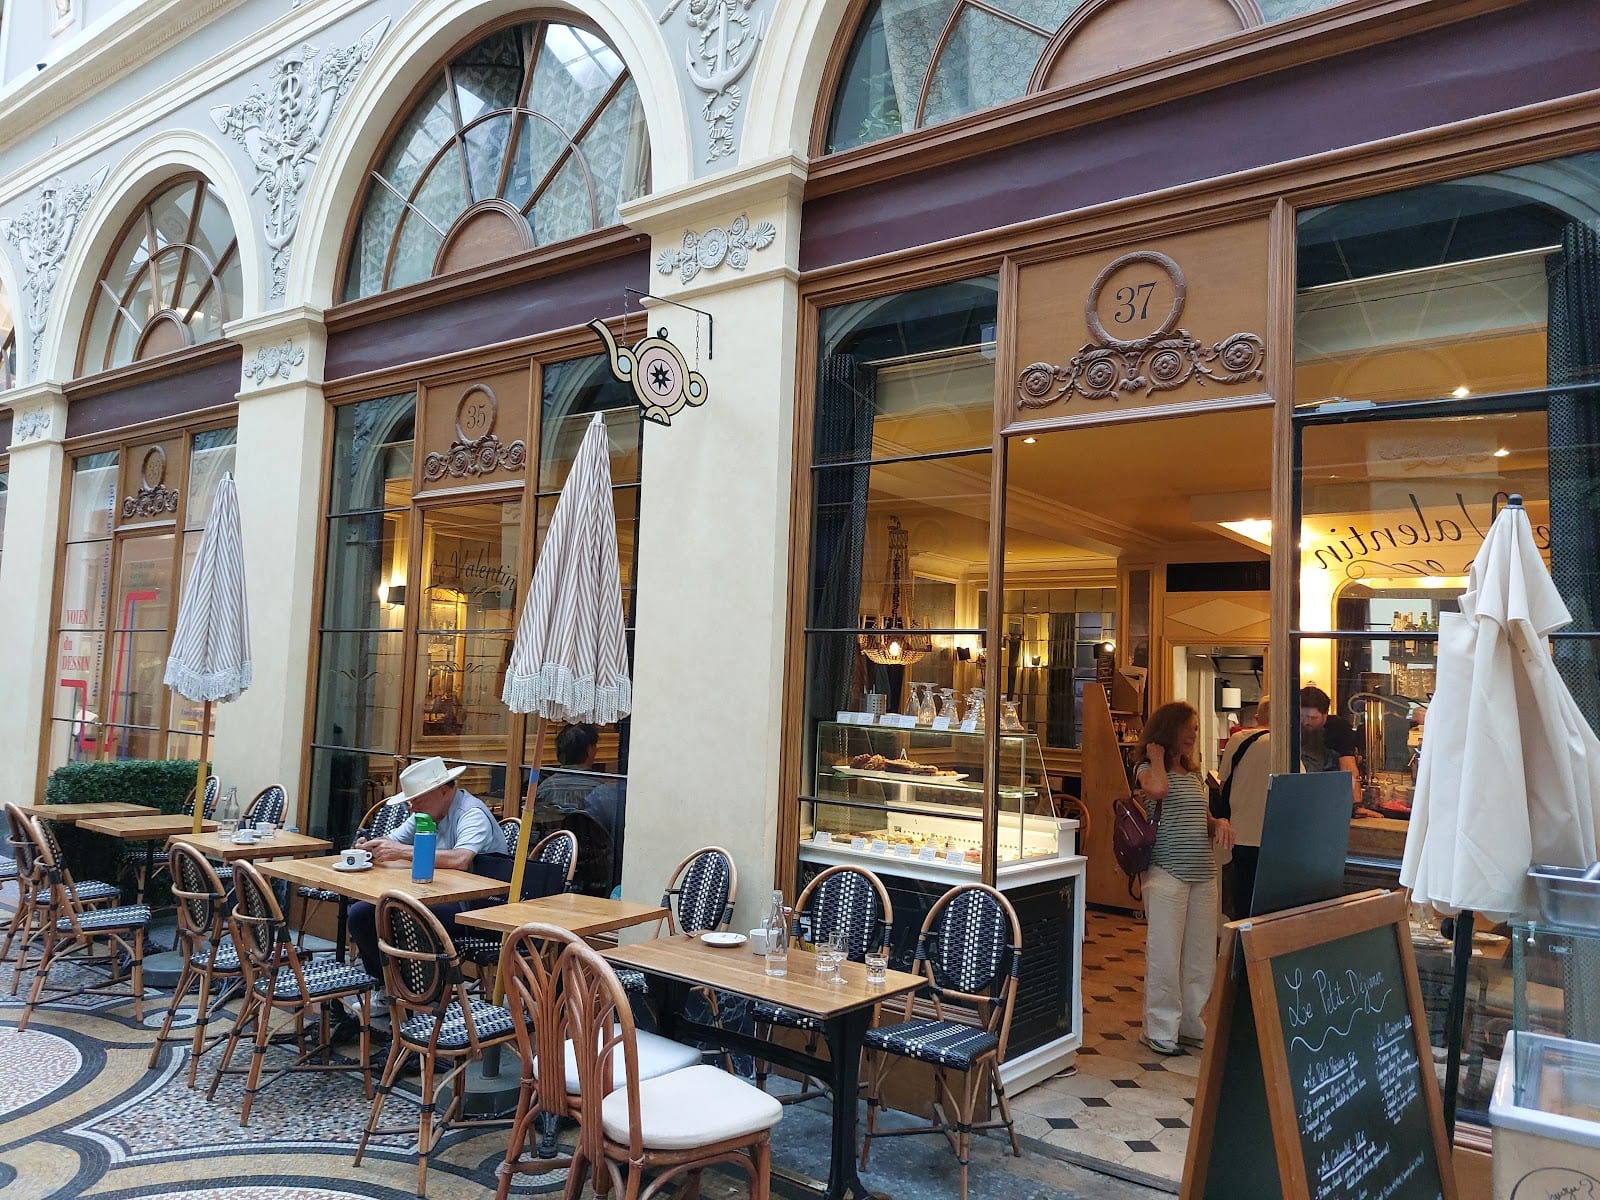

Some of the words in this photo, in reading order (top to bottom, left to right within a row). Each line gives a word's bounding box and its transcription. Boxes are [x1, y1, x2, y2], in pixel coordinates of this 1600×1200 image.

[1114, 281, 1158, 324] 37
[466, 404, 487, 430] 35
[451, 547, 516, 591] Valentin
[65, 609, 89, 625] VOIES
[63, 636, 73, 651] du
[62, 655, 91, 672] DESSIN
[1283, 967, 1314, 1027] Le
